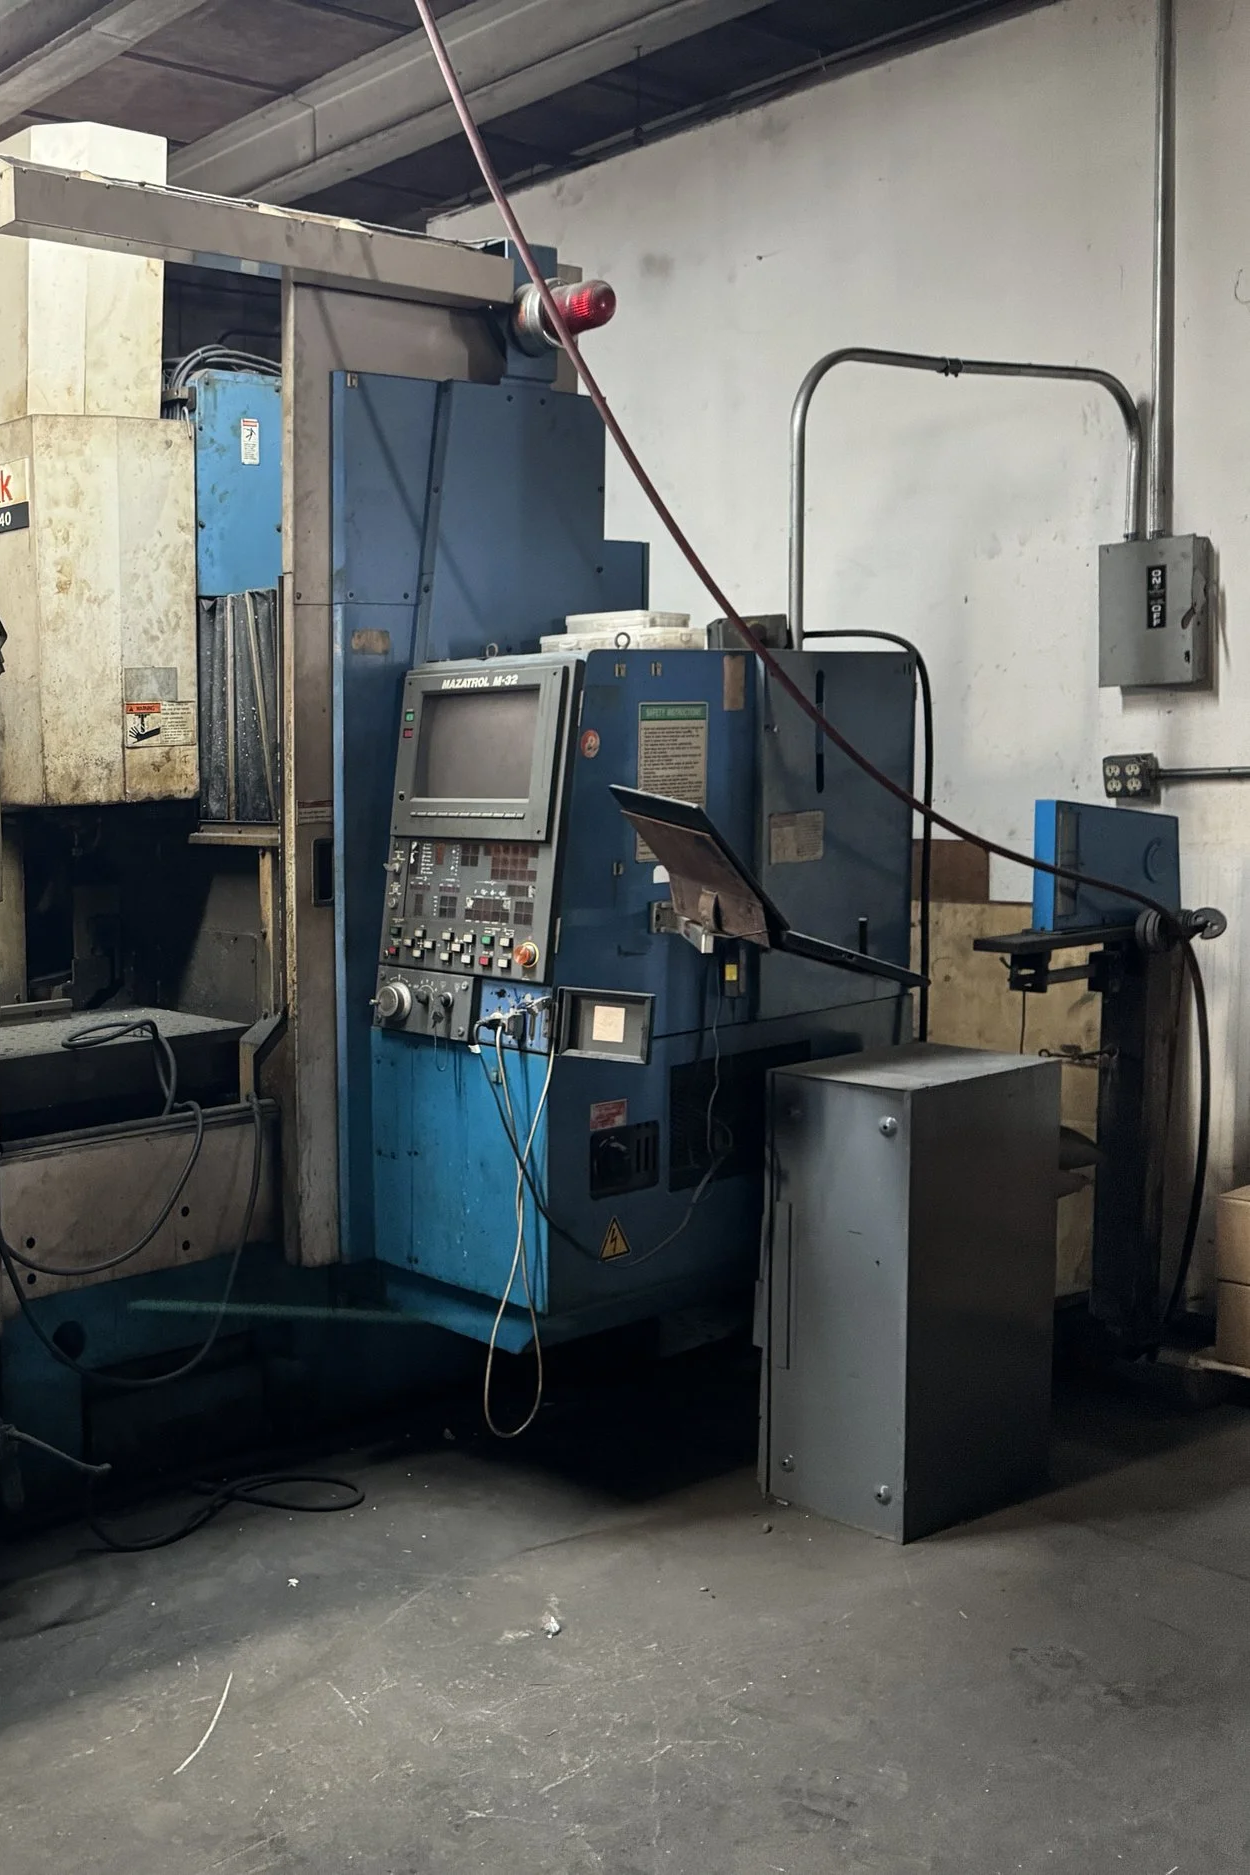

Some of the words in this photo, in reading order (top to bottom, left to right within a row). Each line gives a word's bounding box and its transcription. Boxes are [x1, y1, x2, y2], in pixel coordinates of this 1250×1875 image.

[1151, 569, 1162, 585] ON
[1151, 604, 1162, 627] OFF
[441, 679, 490, 690] MAZATROL
[492, 674, 519, 687] M-32
